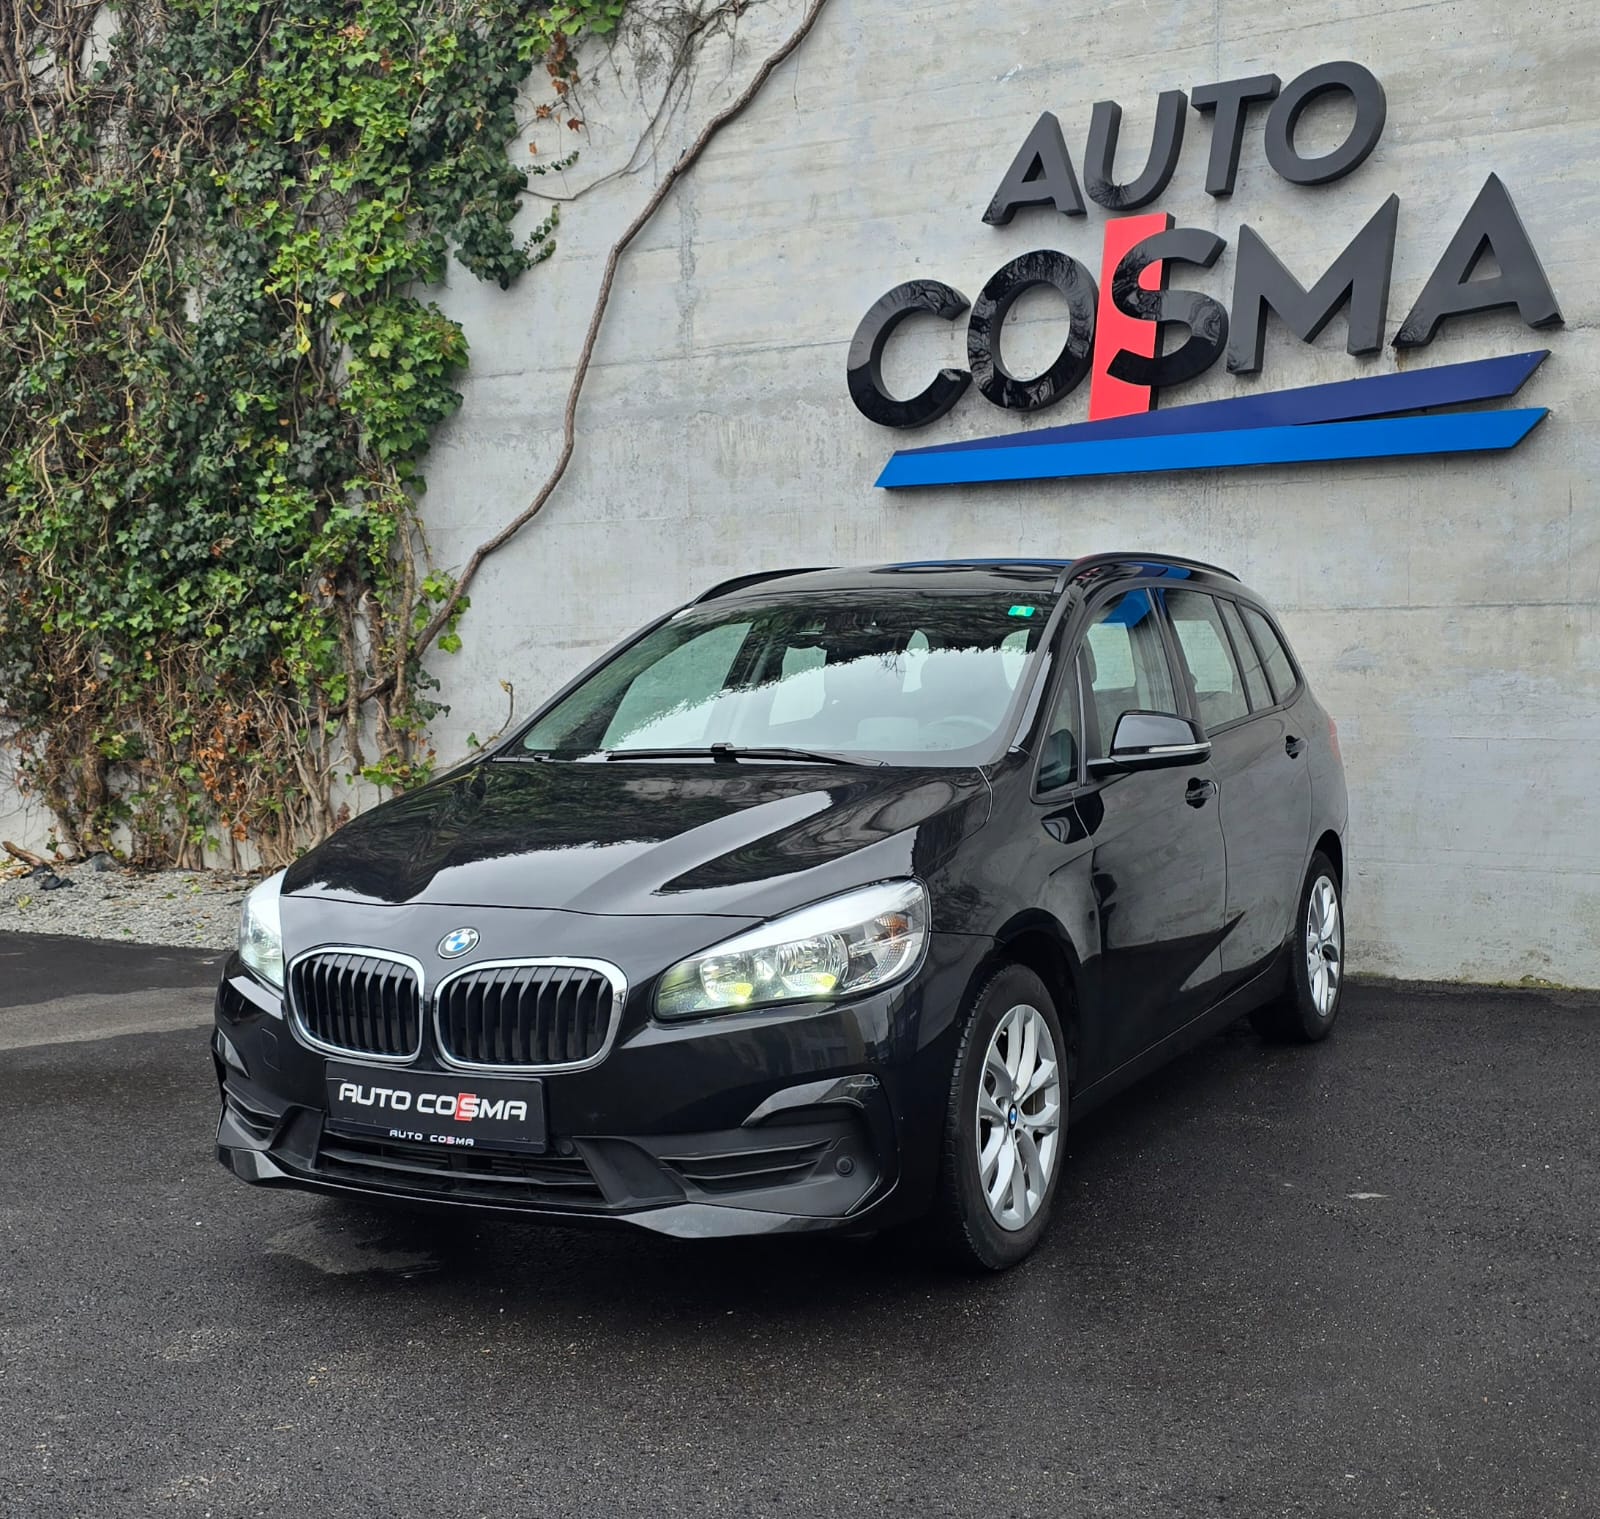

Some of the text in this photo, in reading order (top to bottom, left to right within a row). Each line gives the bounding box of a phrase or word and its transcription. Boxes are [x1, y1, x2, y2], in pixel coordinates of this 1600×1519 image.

[981, 60, 1387, 226] AUTO
[846, 171, 1565, 429] COSMA
[338, 1082, 528, 1121] AUTO COSMA
[389, 1129, 475, 1147] AUTO COSMA
